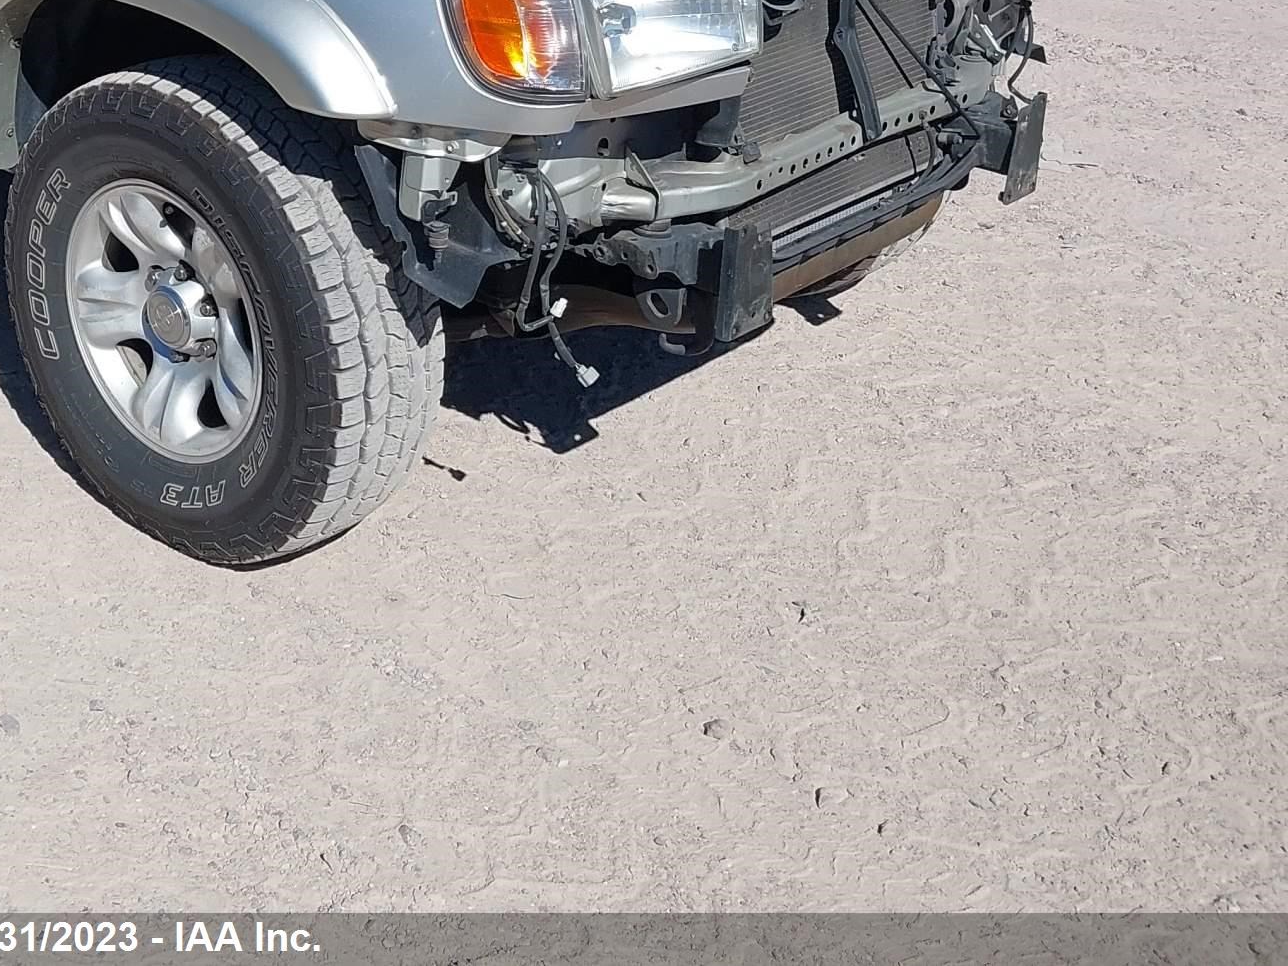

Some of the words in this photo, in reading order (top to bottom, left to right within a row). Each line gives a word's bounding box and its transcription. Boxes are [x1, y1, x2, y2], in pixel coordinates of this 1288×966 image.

[27, 167, 72, 361] COOPER
[190, 186, 280, 489] DISCOVERER
[159, 478, 226, 510] AT3
